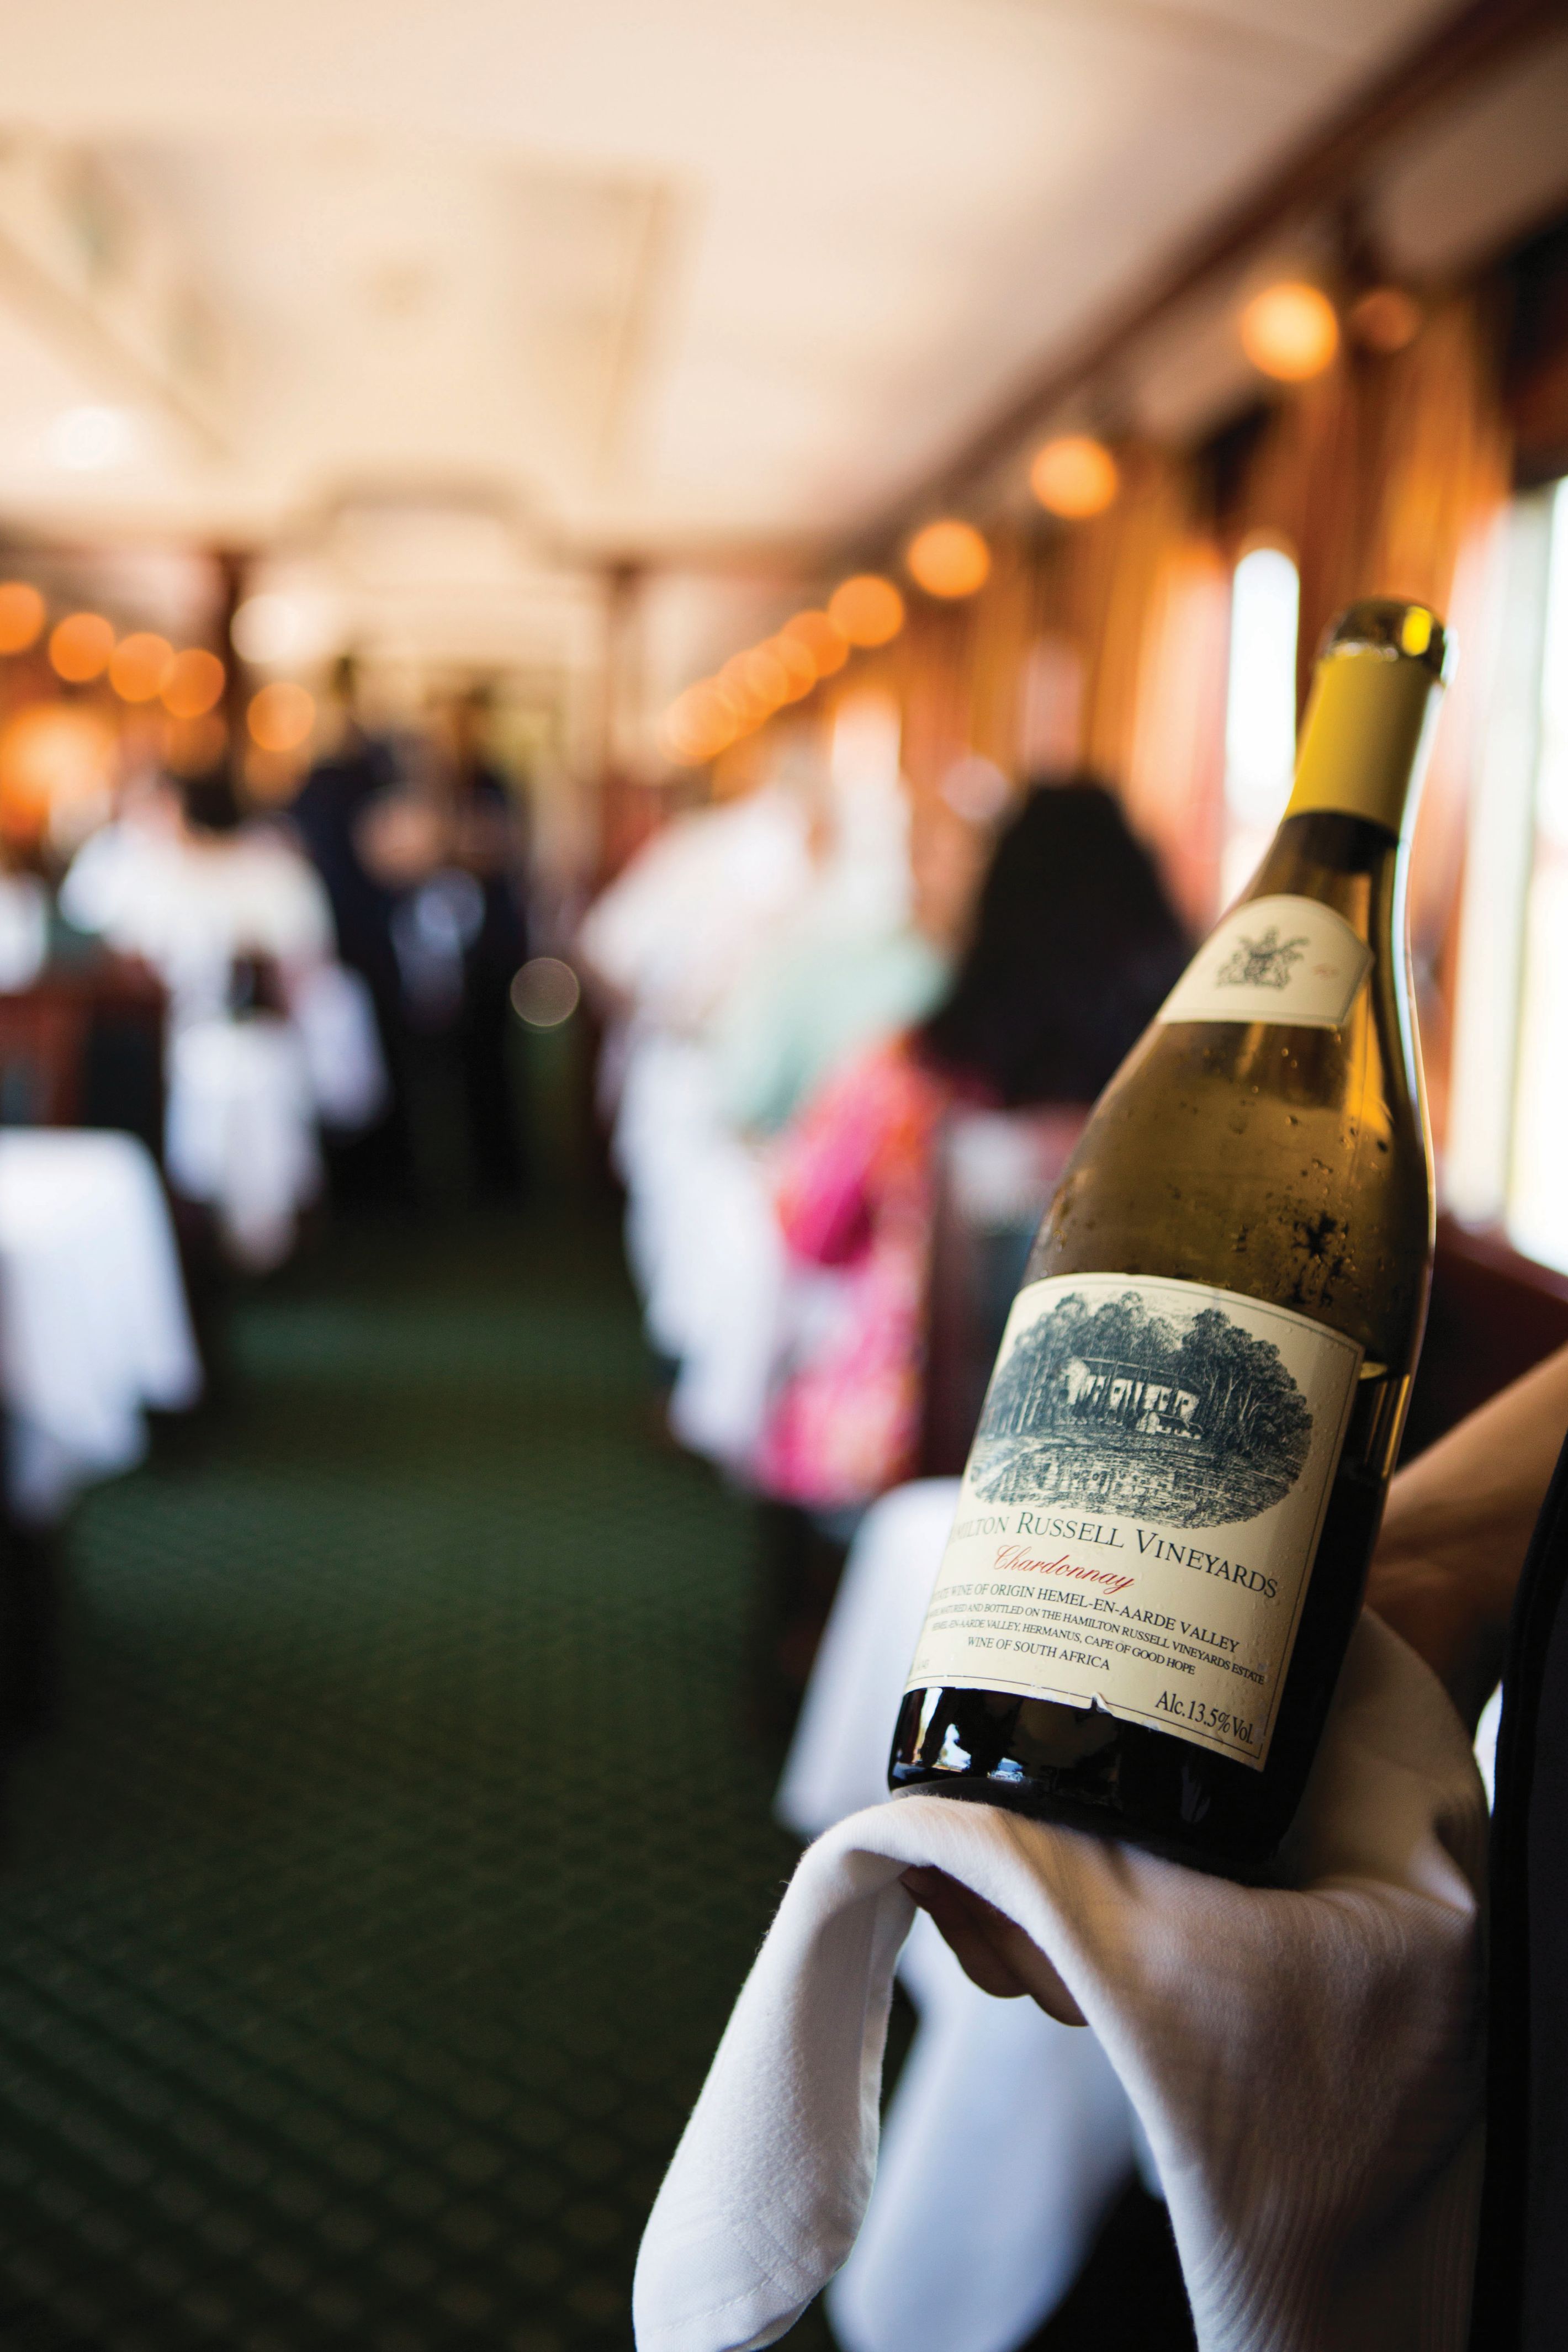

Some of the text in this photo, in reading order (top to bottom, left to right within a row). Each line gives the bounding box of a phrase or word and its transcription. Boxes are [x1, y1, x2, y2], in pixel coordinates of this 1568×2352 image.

[993, 1544, 1135, 1595] Chardonnay
[1016, 1512, 1125, 1548] RUSSELL
[1136, 1529, 1278, 1598] VINEYARDS
[951, 1584, 973, 1596] WINE
[974, 1583, 990, 1596] OF
[990, 1584, 1036, 1598] ORIGIN
[1037, 1588, 1177, 1631] HEMEL-EN-AARDE
[1180, 1621, 1239, 1653] VALLEY
[968, 1603, 984, 1613] AND
[983, 1603, 1024, 1615] BOTTLED
[1025, 1607, 1041, 1617] ON
[1042, 1609, 1062, 1621] THE
[1063, 1613, 1121, 1634] HAMILTON
[1121, 1626, 1170, 1649] RUSSELL
[1173, 1641, 1231, 1671] VINEYARDS
[1231, 1663, 1265, 1685] ESTATE
[987, 1620, 1021, 1633] VALLEY,
[1022, 1623, 1082, 1644] HERMANUS,
[1084, 1635, 1114, 1650] CAPE
[1115, 1643, 1132, 1654] OF
[1132, 1647, 1165, 1665] GOOD
[1166, 1657, 1196, 1675] HOPE
[967, 1636, 1111, 1671] WINE OF SOUTH AFRICA
